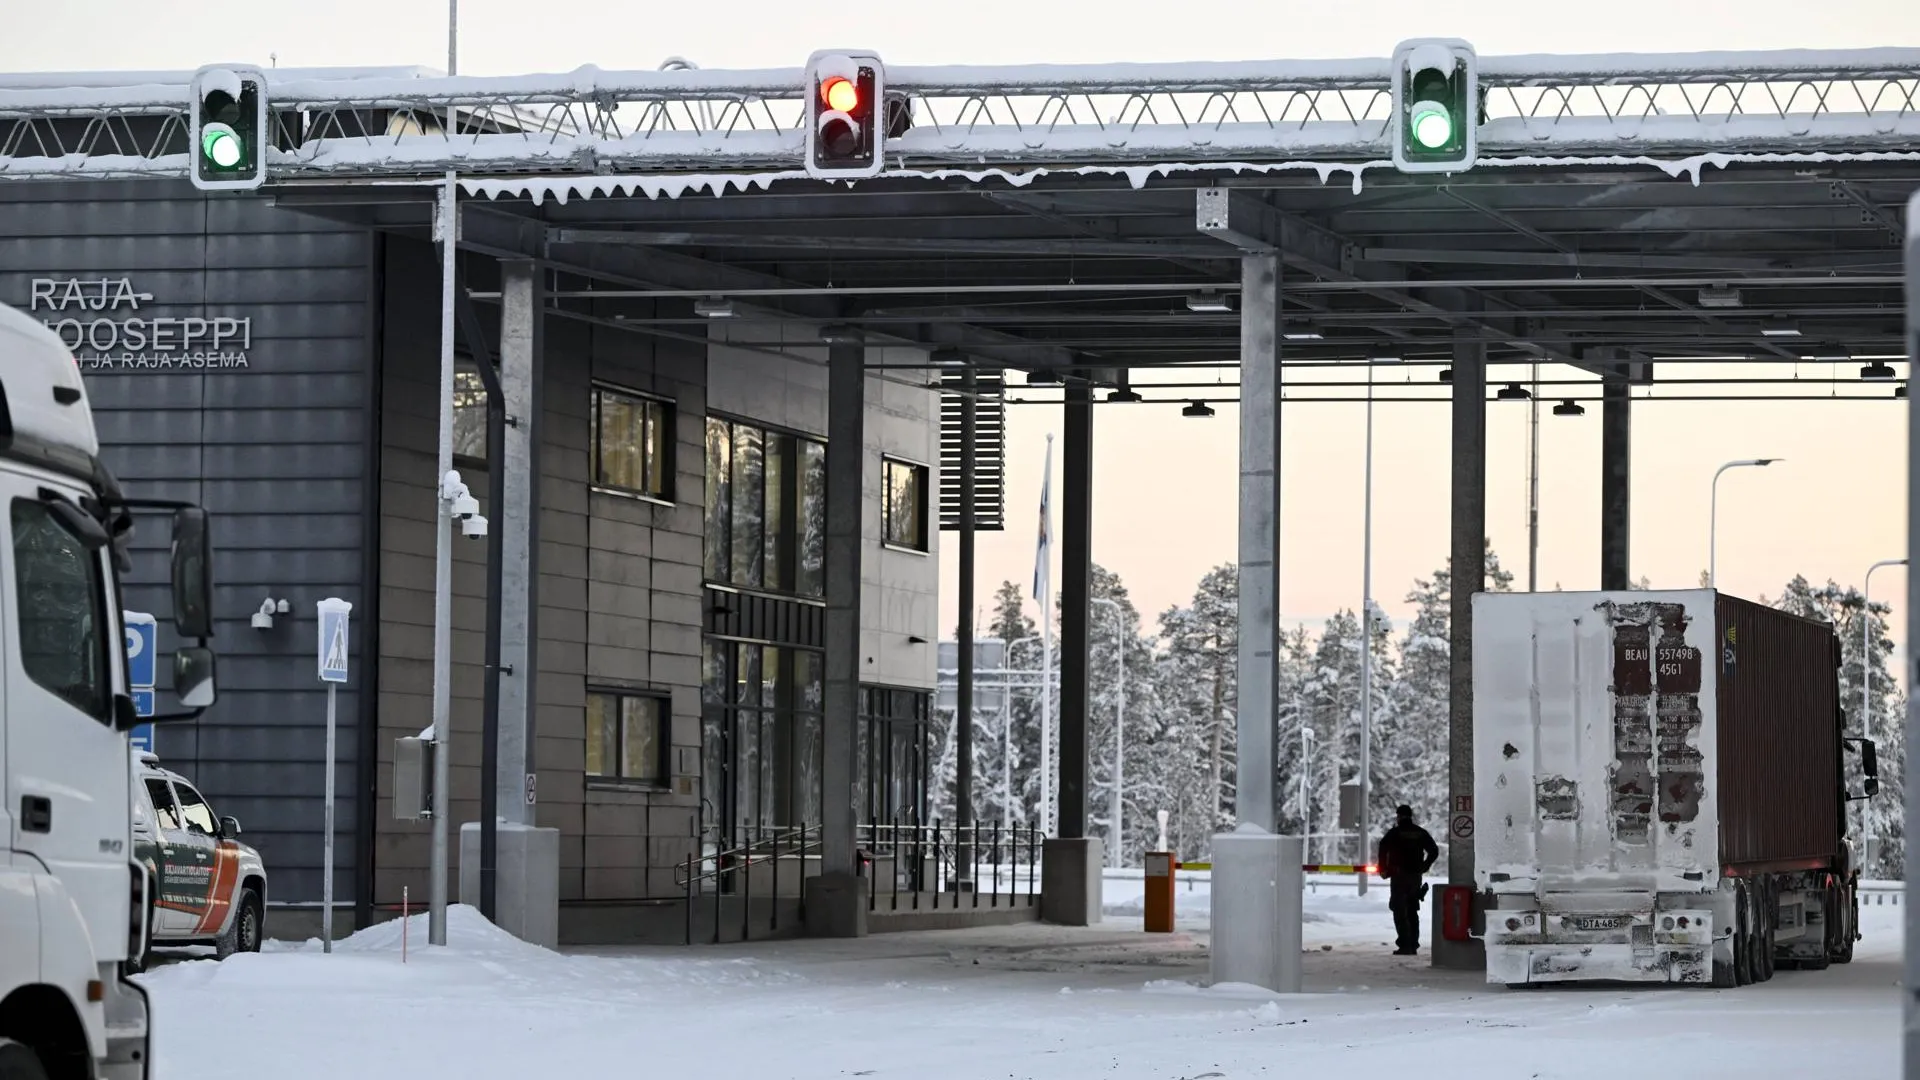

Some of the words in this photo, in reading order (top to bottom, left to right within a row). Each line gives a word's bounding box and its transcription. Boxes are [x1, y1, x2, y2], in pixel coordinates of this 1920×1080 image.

[31, 277, 154, 311] RAJA-
[91, 352, 113, 368] JA
[121, 351, 249, 368] RAJA-ASEMA
[1625, 648, 1648, 661] BEAU
[1659, 648, 1693, 661] 557498
[1659, 663, 1682, 676] 45G1
[1582, 919, 1619, 928] DTA-485
